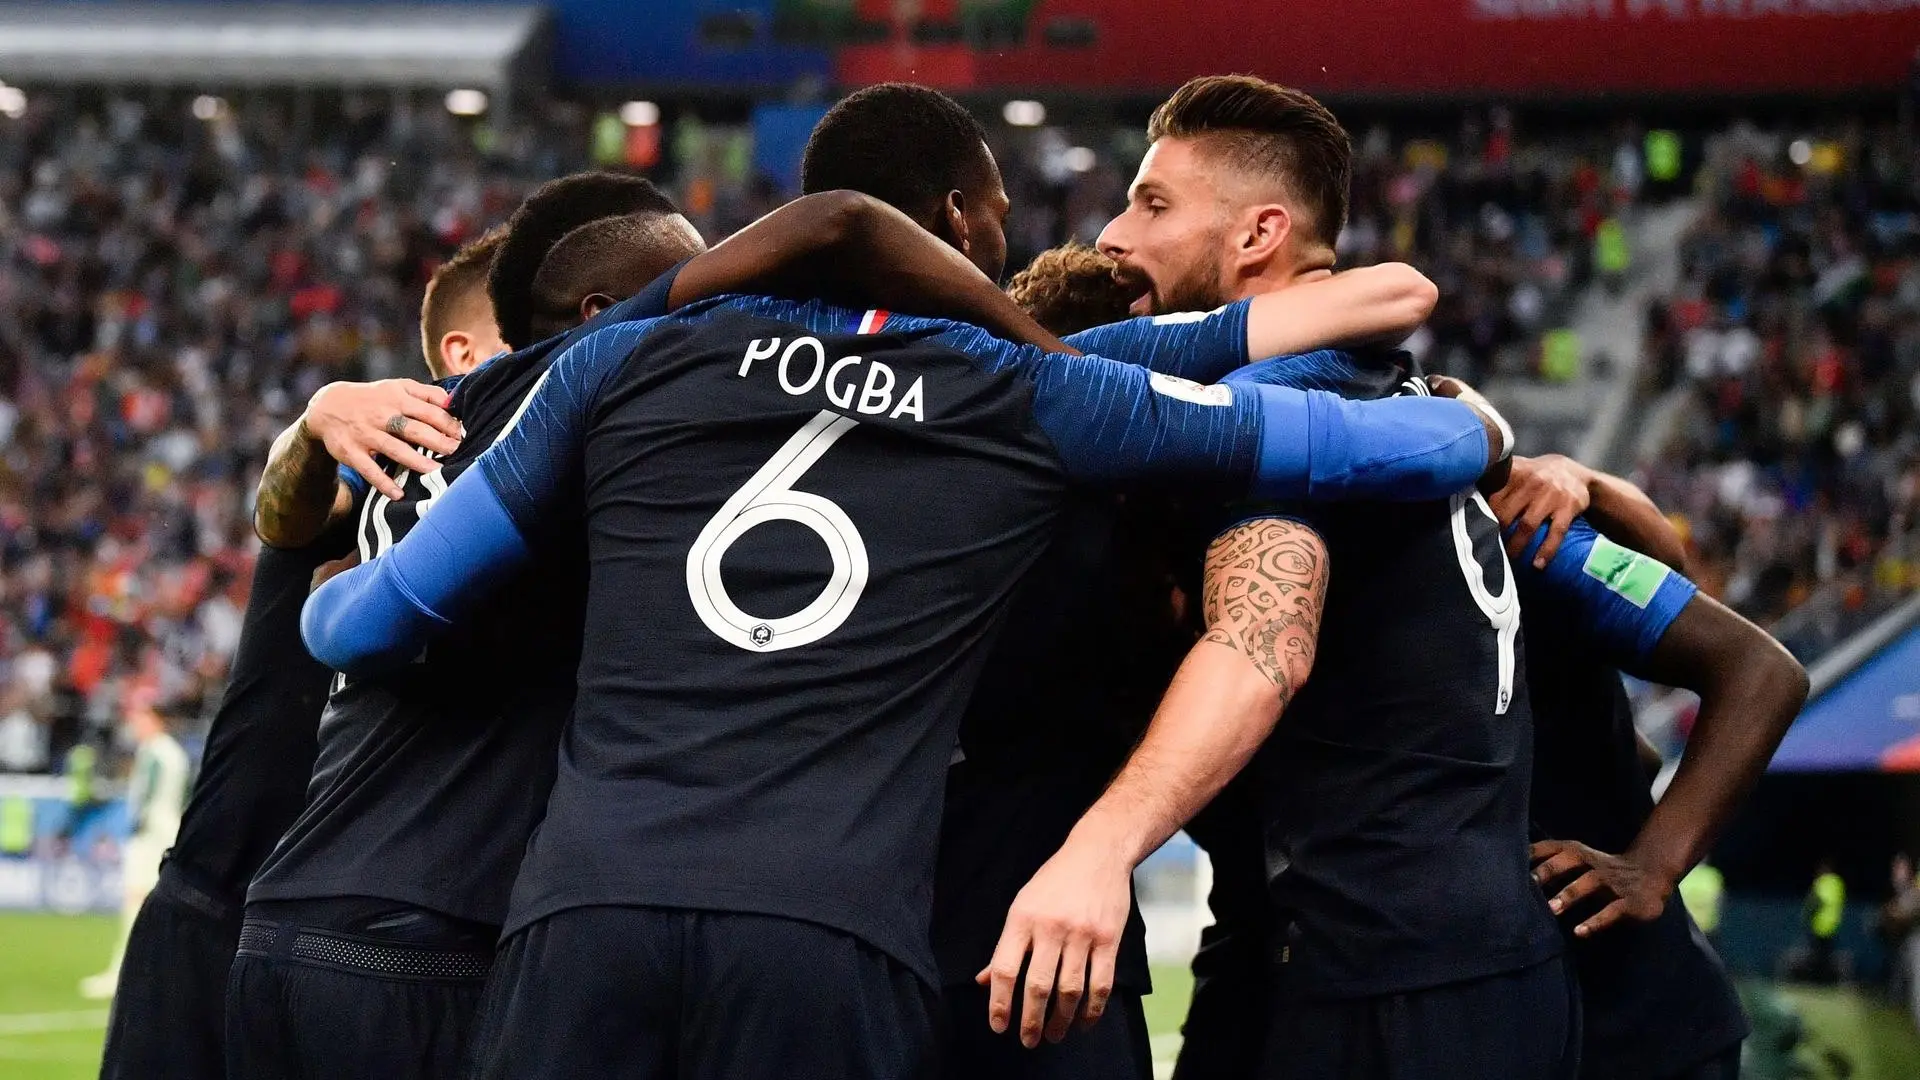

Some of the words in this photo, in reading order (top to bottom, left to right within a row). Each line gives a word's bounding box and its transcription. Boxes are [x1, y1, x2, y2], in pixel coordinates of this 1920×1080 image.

[738, 337, 924, 422] POGBA
[686, 409, 869, 652] 6
[1450, 488, 1521, 715] 9
